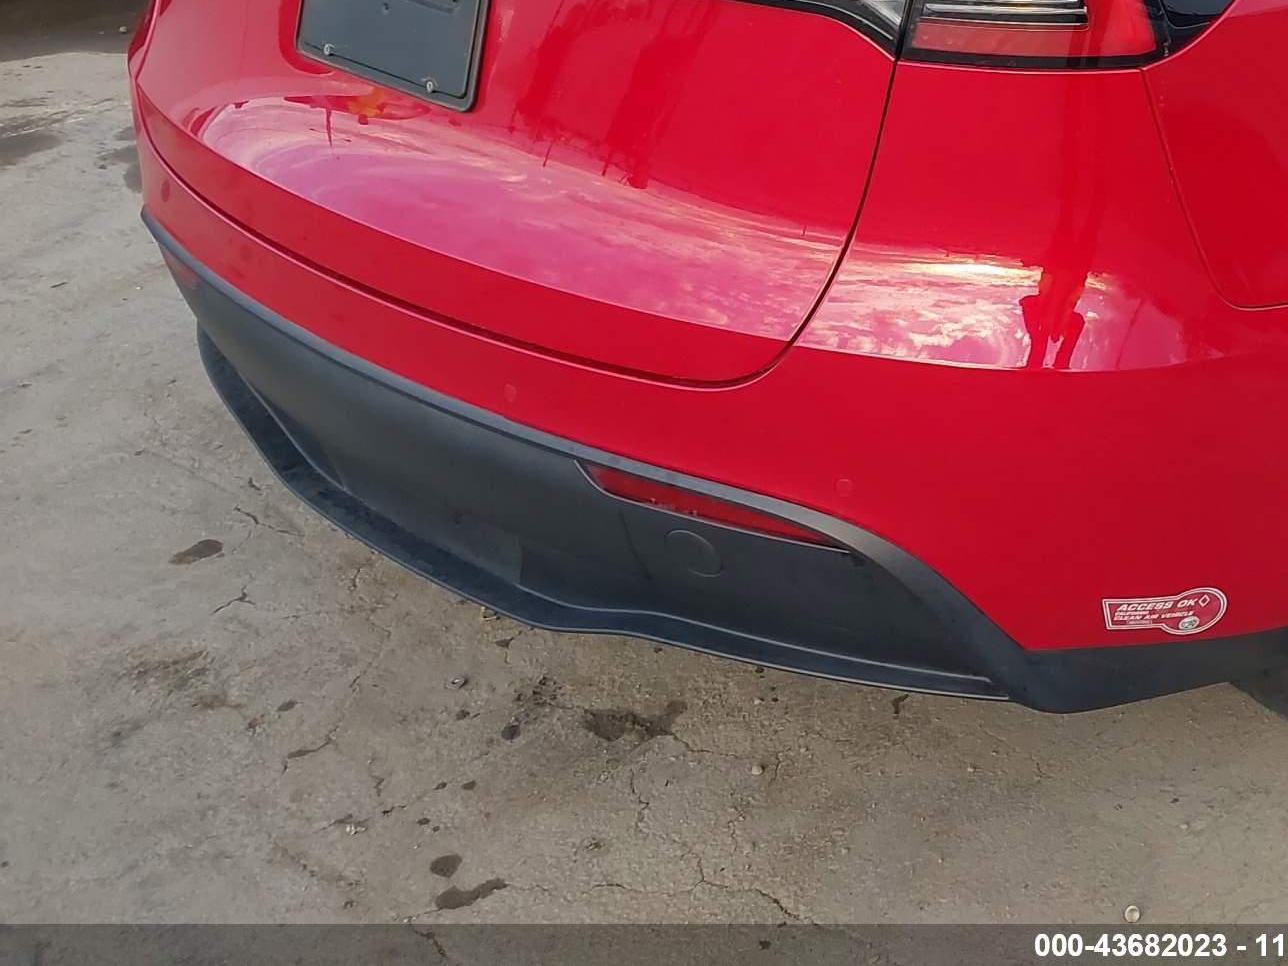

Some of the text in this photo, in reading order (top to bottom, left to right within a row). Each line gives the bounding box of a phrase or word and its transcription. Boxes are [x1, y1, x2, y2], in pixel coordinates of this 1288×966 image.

[1116, 598, 1198, 611] ACCESS OK
[1161, 610, 1195, 618] VEHICLE
